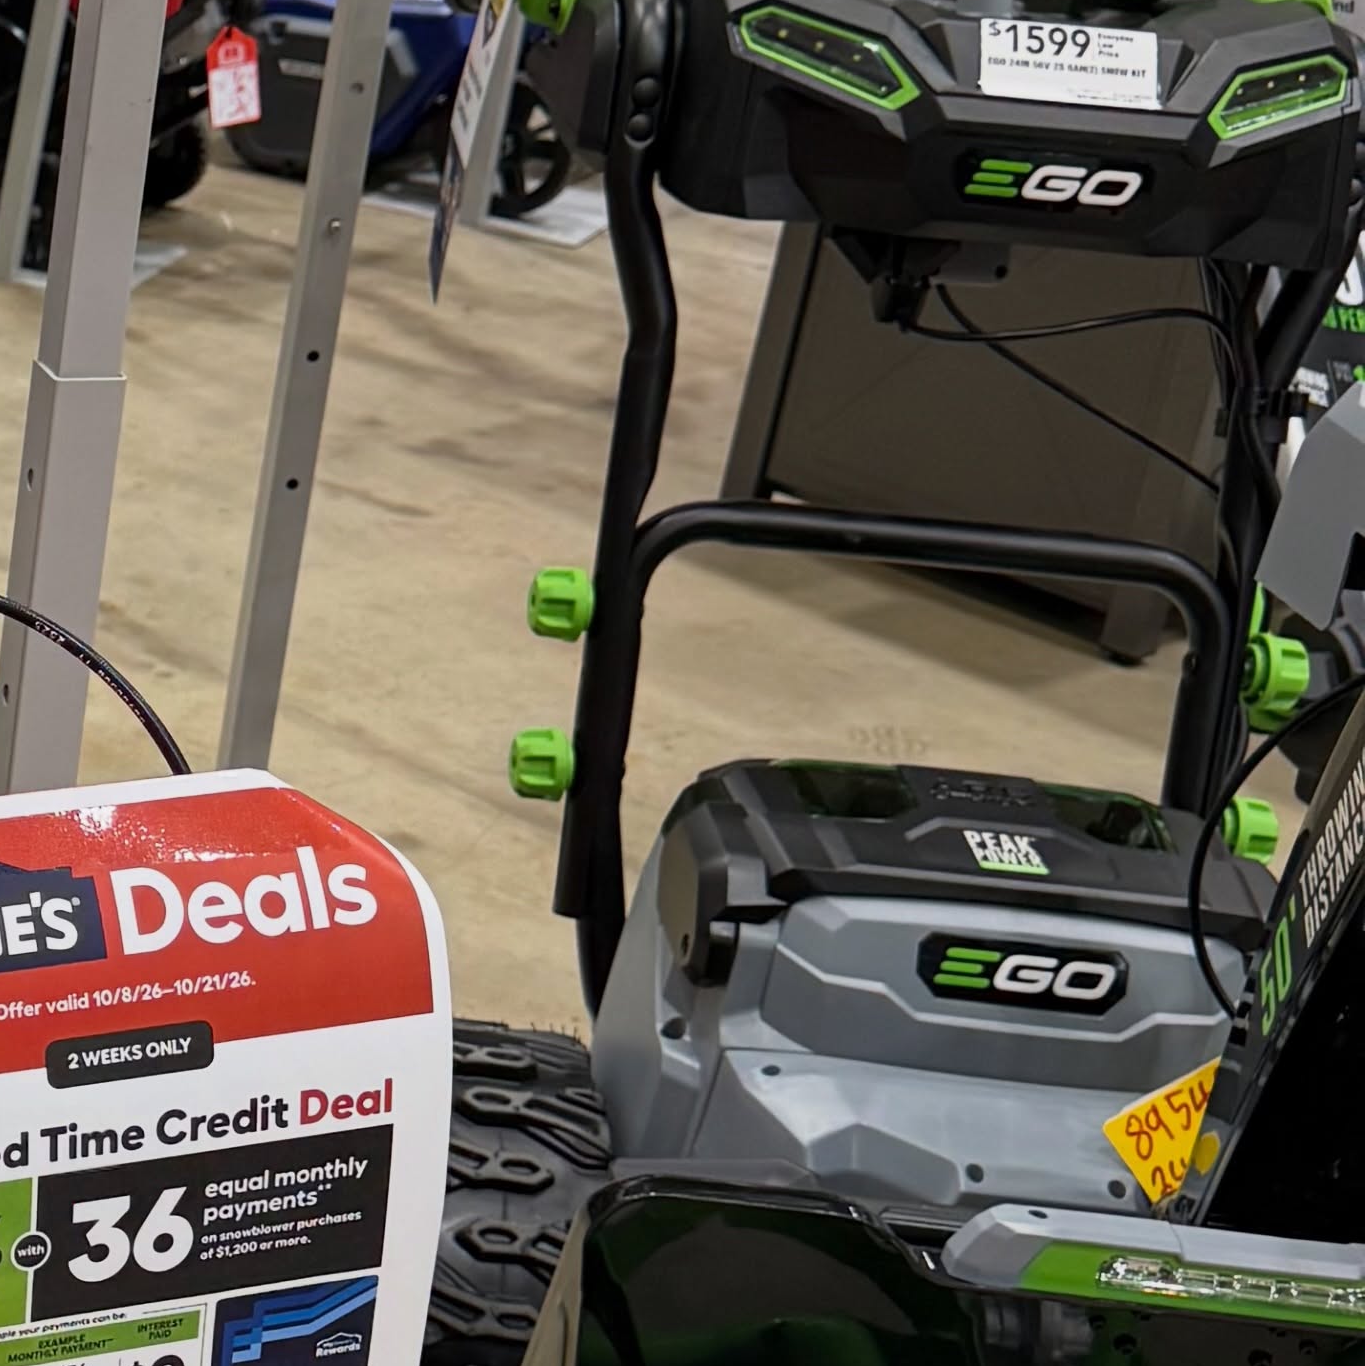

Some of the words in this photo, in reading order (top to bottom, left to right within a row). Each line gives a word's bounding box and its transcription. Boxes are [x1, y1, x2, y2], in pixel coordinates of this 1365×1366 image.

[988, 20, 1091, 58] $1599
[988, 57, 1006, 65] EGO
[1101, 67, 1128, 77] SNOW
[1131, 69, 1147, 78] KIT
[964, 159, 1142, 206] EGO
[1300, 747, 1365, 907] THROWIN
[963, 830, 1033, 852] PEAK
[973, 846, 1045, 869] POWER
[1304, 802, 1365, 949] DISTANC
[109, 845, 378, 956] Deals
[933, 947, 1117, 1000] EGO
[45, 992, 90, 1015] valid
[67, 1053, 80, 1069] 2
[81, 1044, 143, 1067] WEEKS
[145, 1037, 192, 1059] ONLY
[40, 1122, 145, 1164] Time
[156, 1095, 289, 1146] Credit
[300, 1078, 393, 1125] Deal
[204, 1168, 270, 1202] equal
[274, 1156, 369, 1192] monthly
[68, 1186, 194, 1283] 36
[201, 1232, 216, 1245] on
[218, 1221, 295, 1244] snowblower
[296, 1210, 362, 1237] purchases
[17, 1240, 45, 1259] with
[200, 1248, 214, 1261] of
[215, 1239, 258, 1260] $1,200
[259, 1241, 273, 1253] or
[274, 1235, 312, 1251] more.
[18, 1326, 40, 1340] your
[42, 1318, 91, 1337] payments
[92, 1315, 111, 1325] can
[137, 1318, 183, 1334] INTEREST
[148, 1328, 172, 1341] PAID
[38, 1334, 86, 1349] EXAMPLE
[315, 1343, 361, 1357] Rewards
[7, 1346, 59, 1364] MONTHLY
